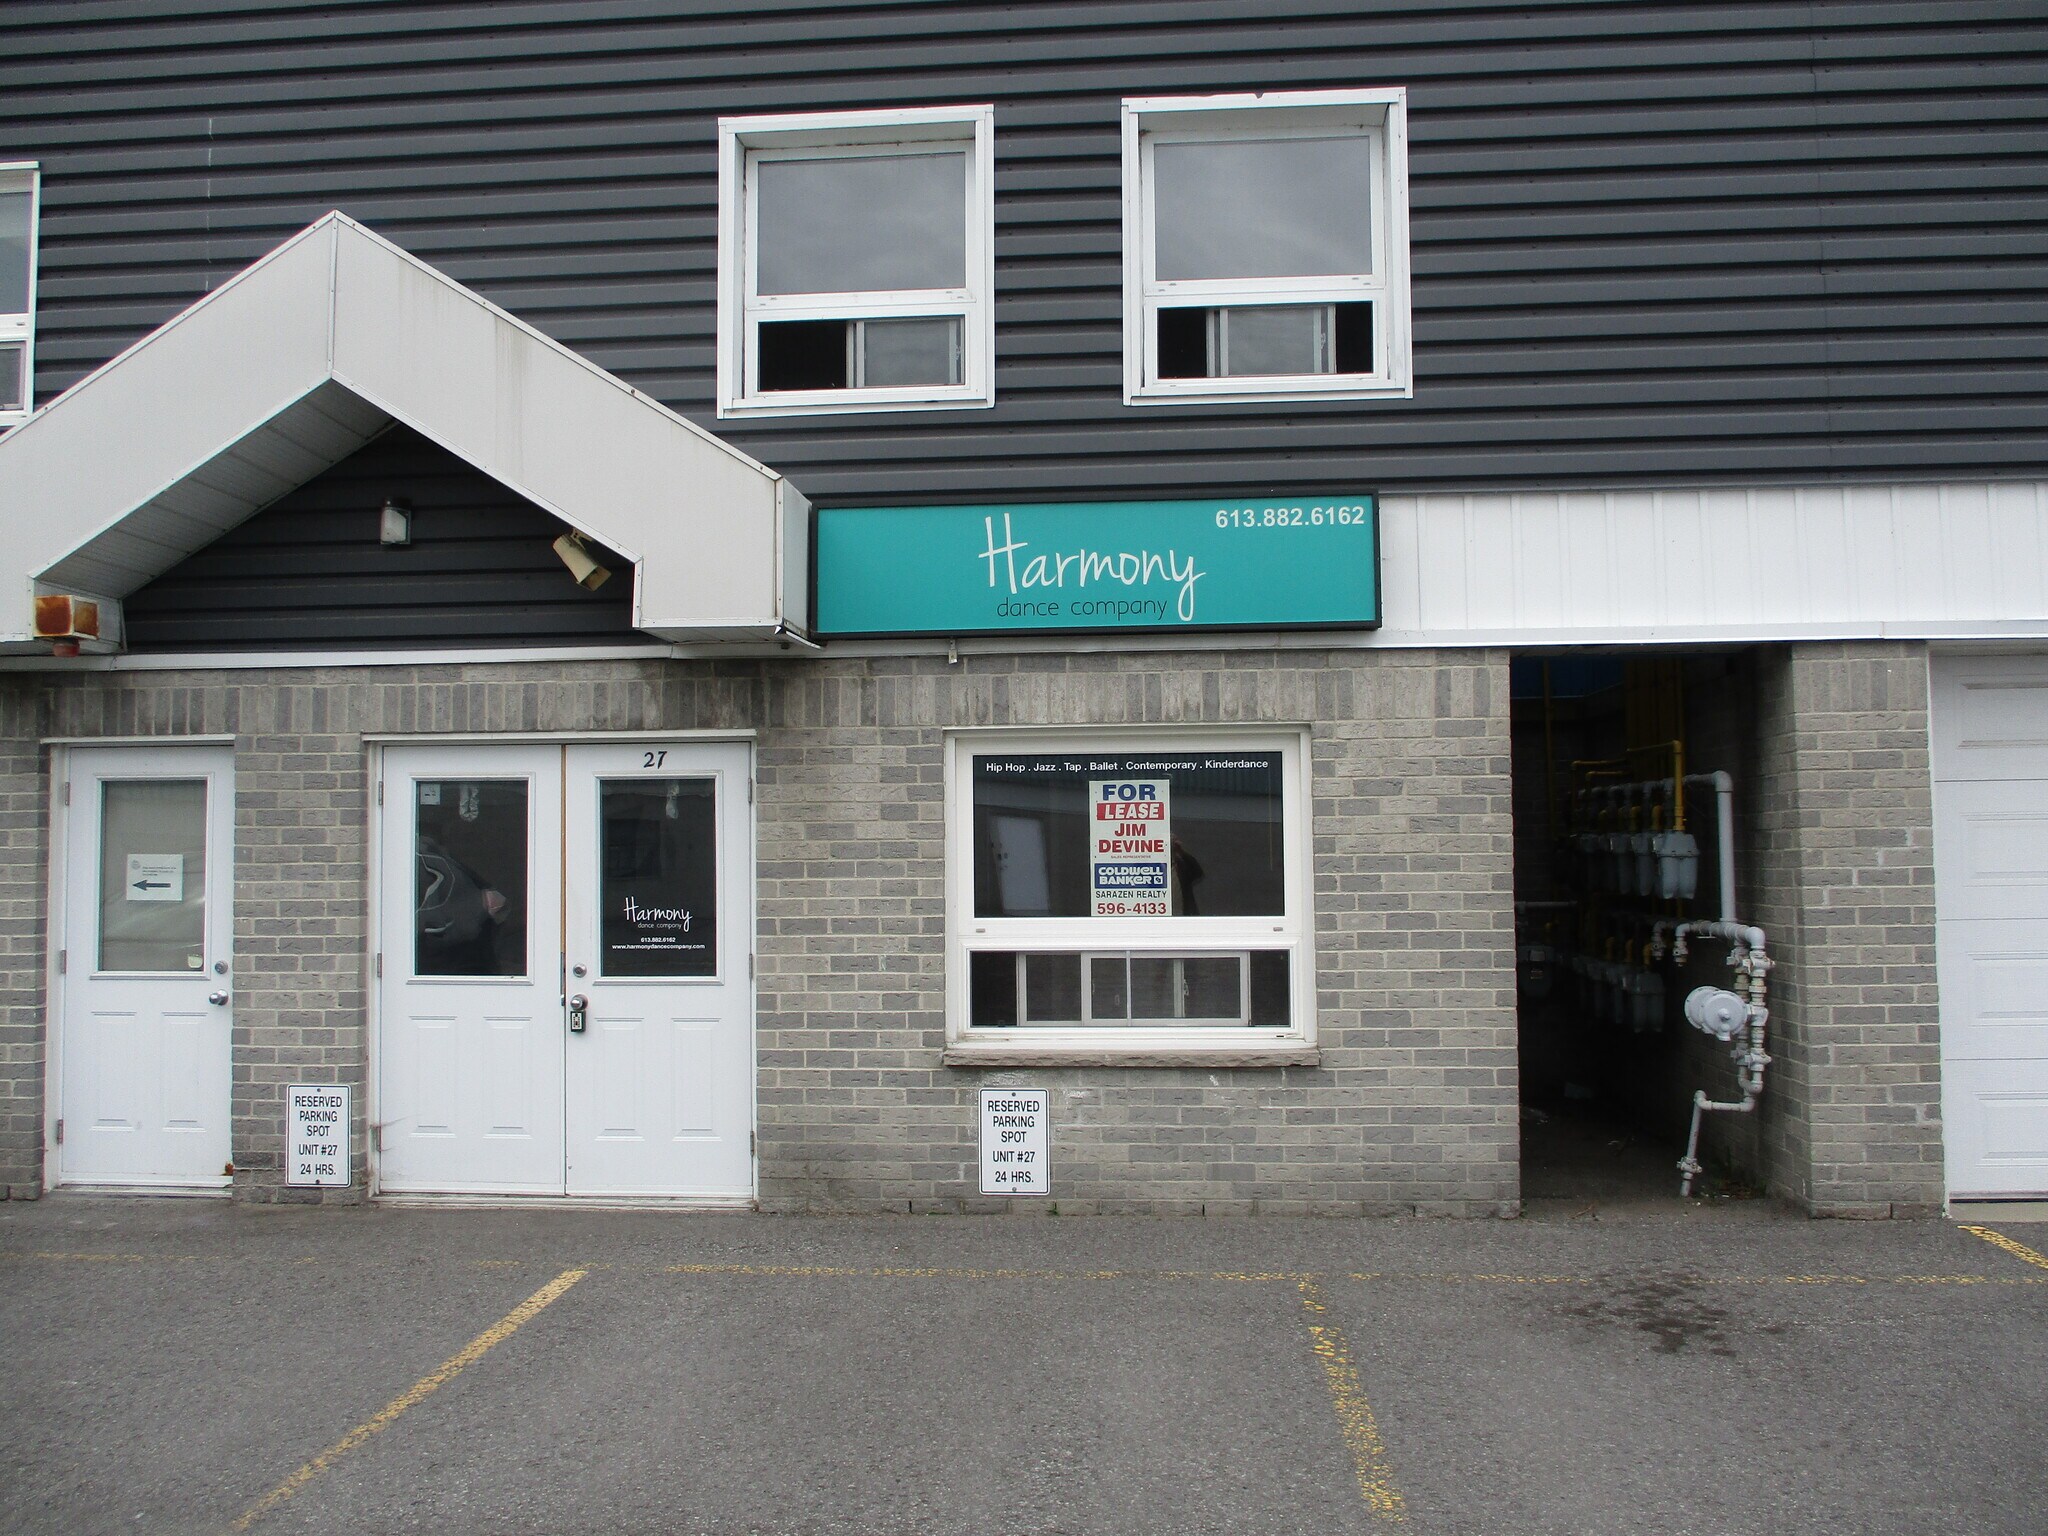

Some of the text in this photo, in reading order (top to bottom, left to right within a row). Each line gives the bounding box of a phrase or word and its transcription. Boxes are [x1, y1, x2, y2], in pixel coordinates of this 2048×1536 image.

[1215, 506, 1364, 528] 613.882.6162
[978, 512, 1206, 622] Harmony
[996, 597, 1168, 621] dance company
[643, 750, 668, 769] 27
[986, 759, 1268, 773] Hip Hop Jazz Tap Ballet Contemporary Kinderdance
[1102, 783, 1156, 801] FOR
[1104, 803, 1160, 819] LEASE
[1114, 823, 1146, 837] JIM
[1098, 839, 1164, 853] DEVINE
[1095, 890, 1167, 899] SARAZEN REALTY
[623, 896, 693, 932] Harmony
[1097, 902, 1167, 915] 596-4133
[637, 921, 682, 930] dance company
[294, 1095, 343, 1108] RESERVED
[987, 1100, 1040, 1112] RESERVED
[299, 1110, 338, 1122] PARKING
[992, 1115, 1035, 1128] PARKING
[306, 1125, 330, 1136] SPOT
[1000, 1130, 1027, 1143] SPOT
[298, 1143, 338, 1156] UNIT #27
[992, 1150, 1036, 1163] UNIT #27
[300, 1163, 337, 1175] 24 HRS.
[994, 1170, 1035, 1183] 24 HRS.
